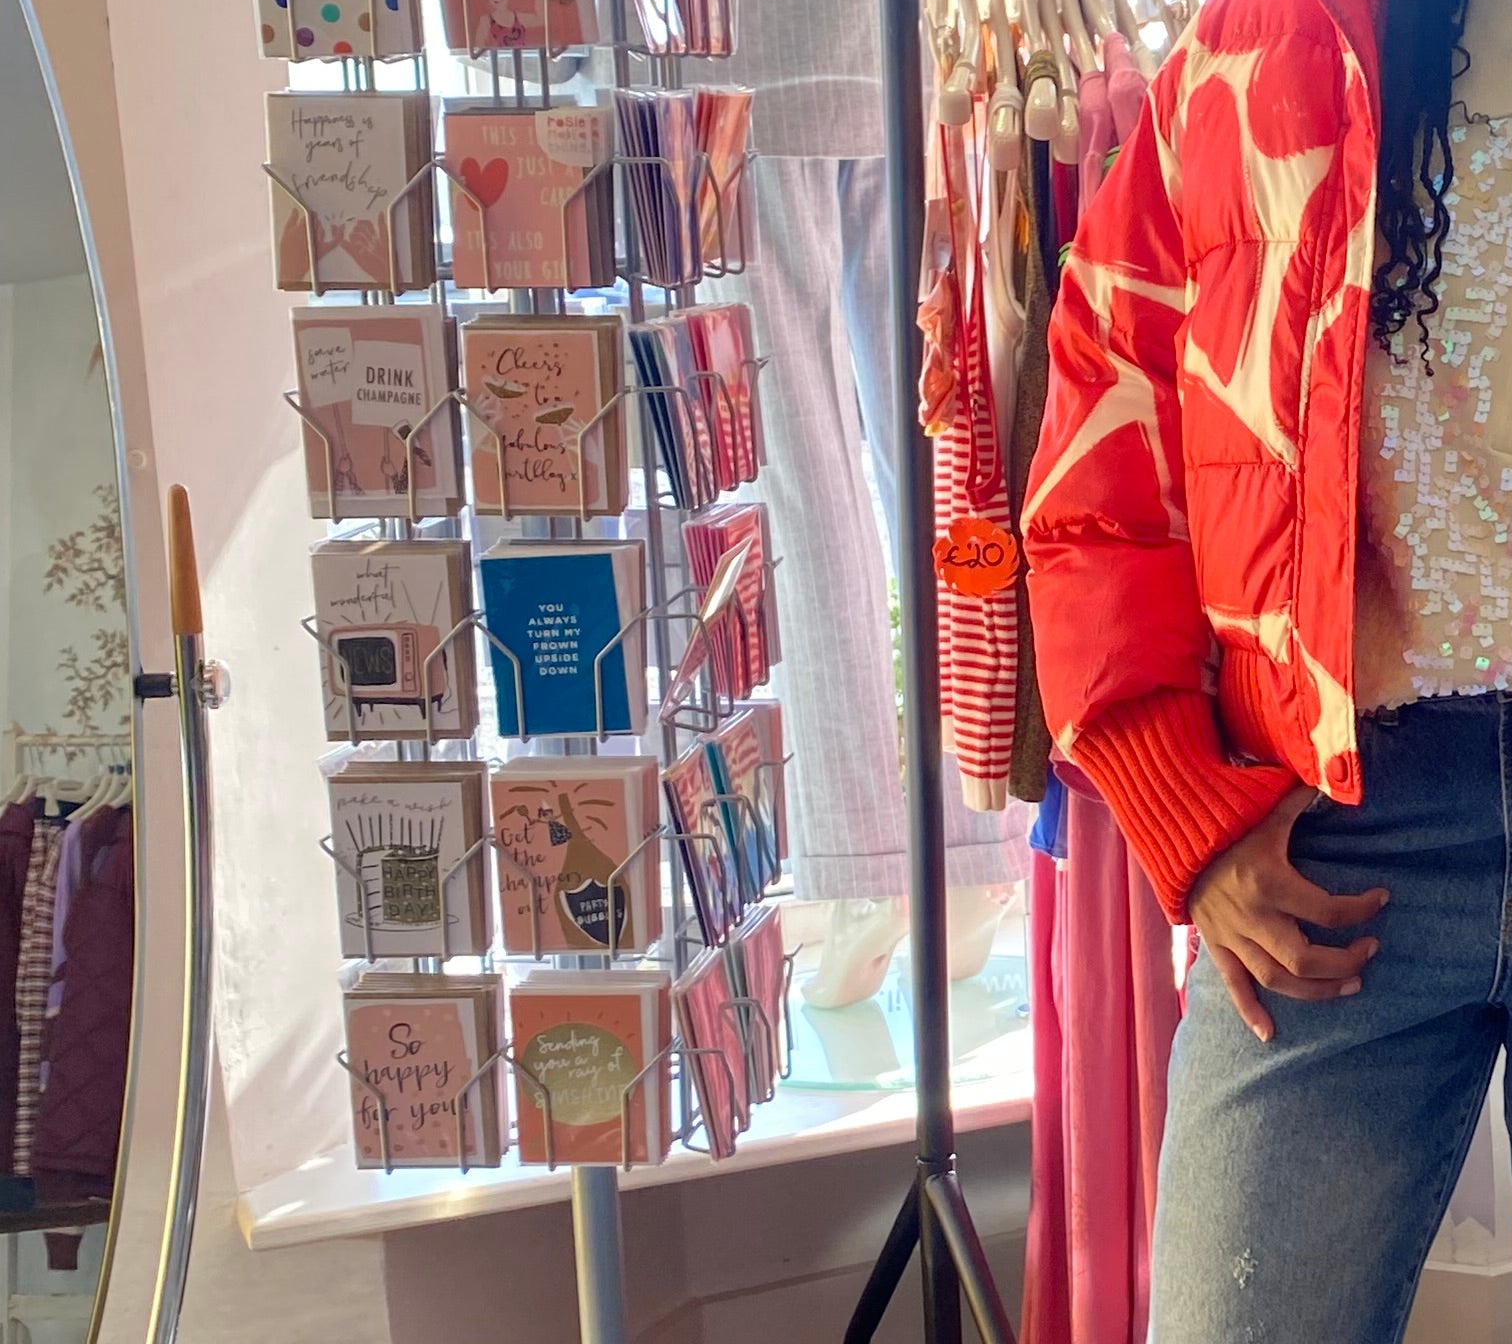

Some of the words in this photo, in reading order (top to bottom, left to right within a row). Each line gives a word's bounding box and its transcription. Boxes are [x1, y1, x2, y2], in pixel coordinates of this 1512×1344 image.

[495, 346, 562, 377] Cheers
[365, 366, 415, 388] DRINK
[356, 388, 422, 406] CHAMPAGNE
[942, 542, 1005, 569] £20
[538, 603, 564, 613] YOU
[528, 615, 577, 626] ALWAYS
[526, 628, 560, 638] TURN
[564, 628, 581, 637] MY
[533, 640, 579, 651] FROWN
[535, 652, 579, 664] UPSIDE
[539, 665, 578, 676] DOWN
[501, 823, 536, 848] Get
[513, 847, 546, 867] the
[382, 864, 436, 881] HAPPY
[383, 883, 436, 899] BIRTH
[388, 1022, 427, 1060] So
[536, 1029, 601, 1057] Sending
[363, 1059, 457, 1094] happy
[533, 1057, 571, 1083] you
[568, 1065, 602, 1088] ray
